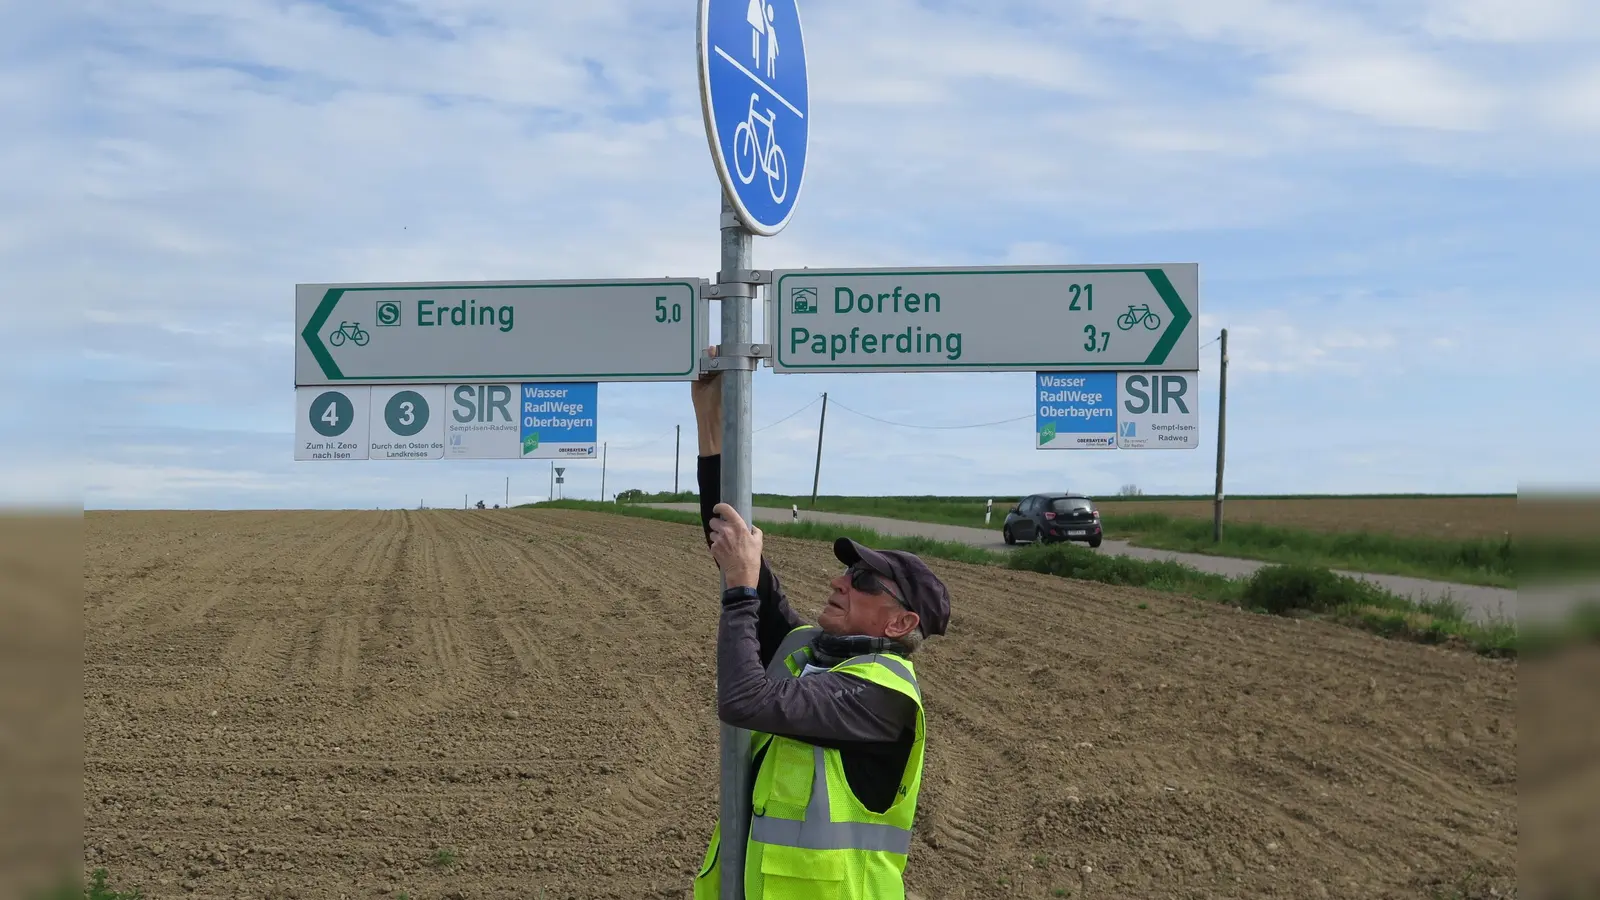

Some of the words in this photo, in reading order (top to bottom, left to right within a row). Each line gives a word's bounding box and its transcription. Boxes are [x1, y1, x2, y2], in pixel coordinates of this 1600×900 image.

[834, 286, 941, 313] Dorfen
[1068, 283, 1094, 311] 21
[417, 299, 514, 332] Erding
[655, 296, 682, 324] 5,0
[791, 326, 962, 361] Papferding
[1084, 325, 1110, 353] 3,7
[1040, 375, 1086, 387] Wasser
[525, 387, 568, 398] Wasser
[1040, 390, 1102, 404] RadlWege
[1124, 374, 1190, 414] SIR
[452, 384, 512, 423] SIR
[524, 401, 584, 415] RadlWege
[321, 401, 339, 426] 4
[399, 401, 415, 426] 3
[1039, 406, 1113, 421] Oberbayern
[449, 424, 518, 432] Sempt-Isen-Radweg
[524, 416, 593, 430] Oberbayern
[1151, 423, 1196, 432] Sempt-Isen-
[1158, 434, 1188, 443] Radweg
[306, 442, 324, 450] Zum
[325, 442, 336, 450] hl.
[337, 442, 358, 450] Zeno
[312, 451, 333, 459] nach
[334, 451, 351, 459] Isen
